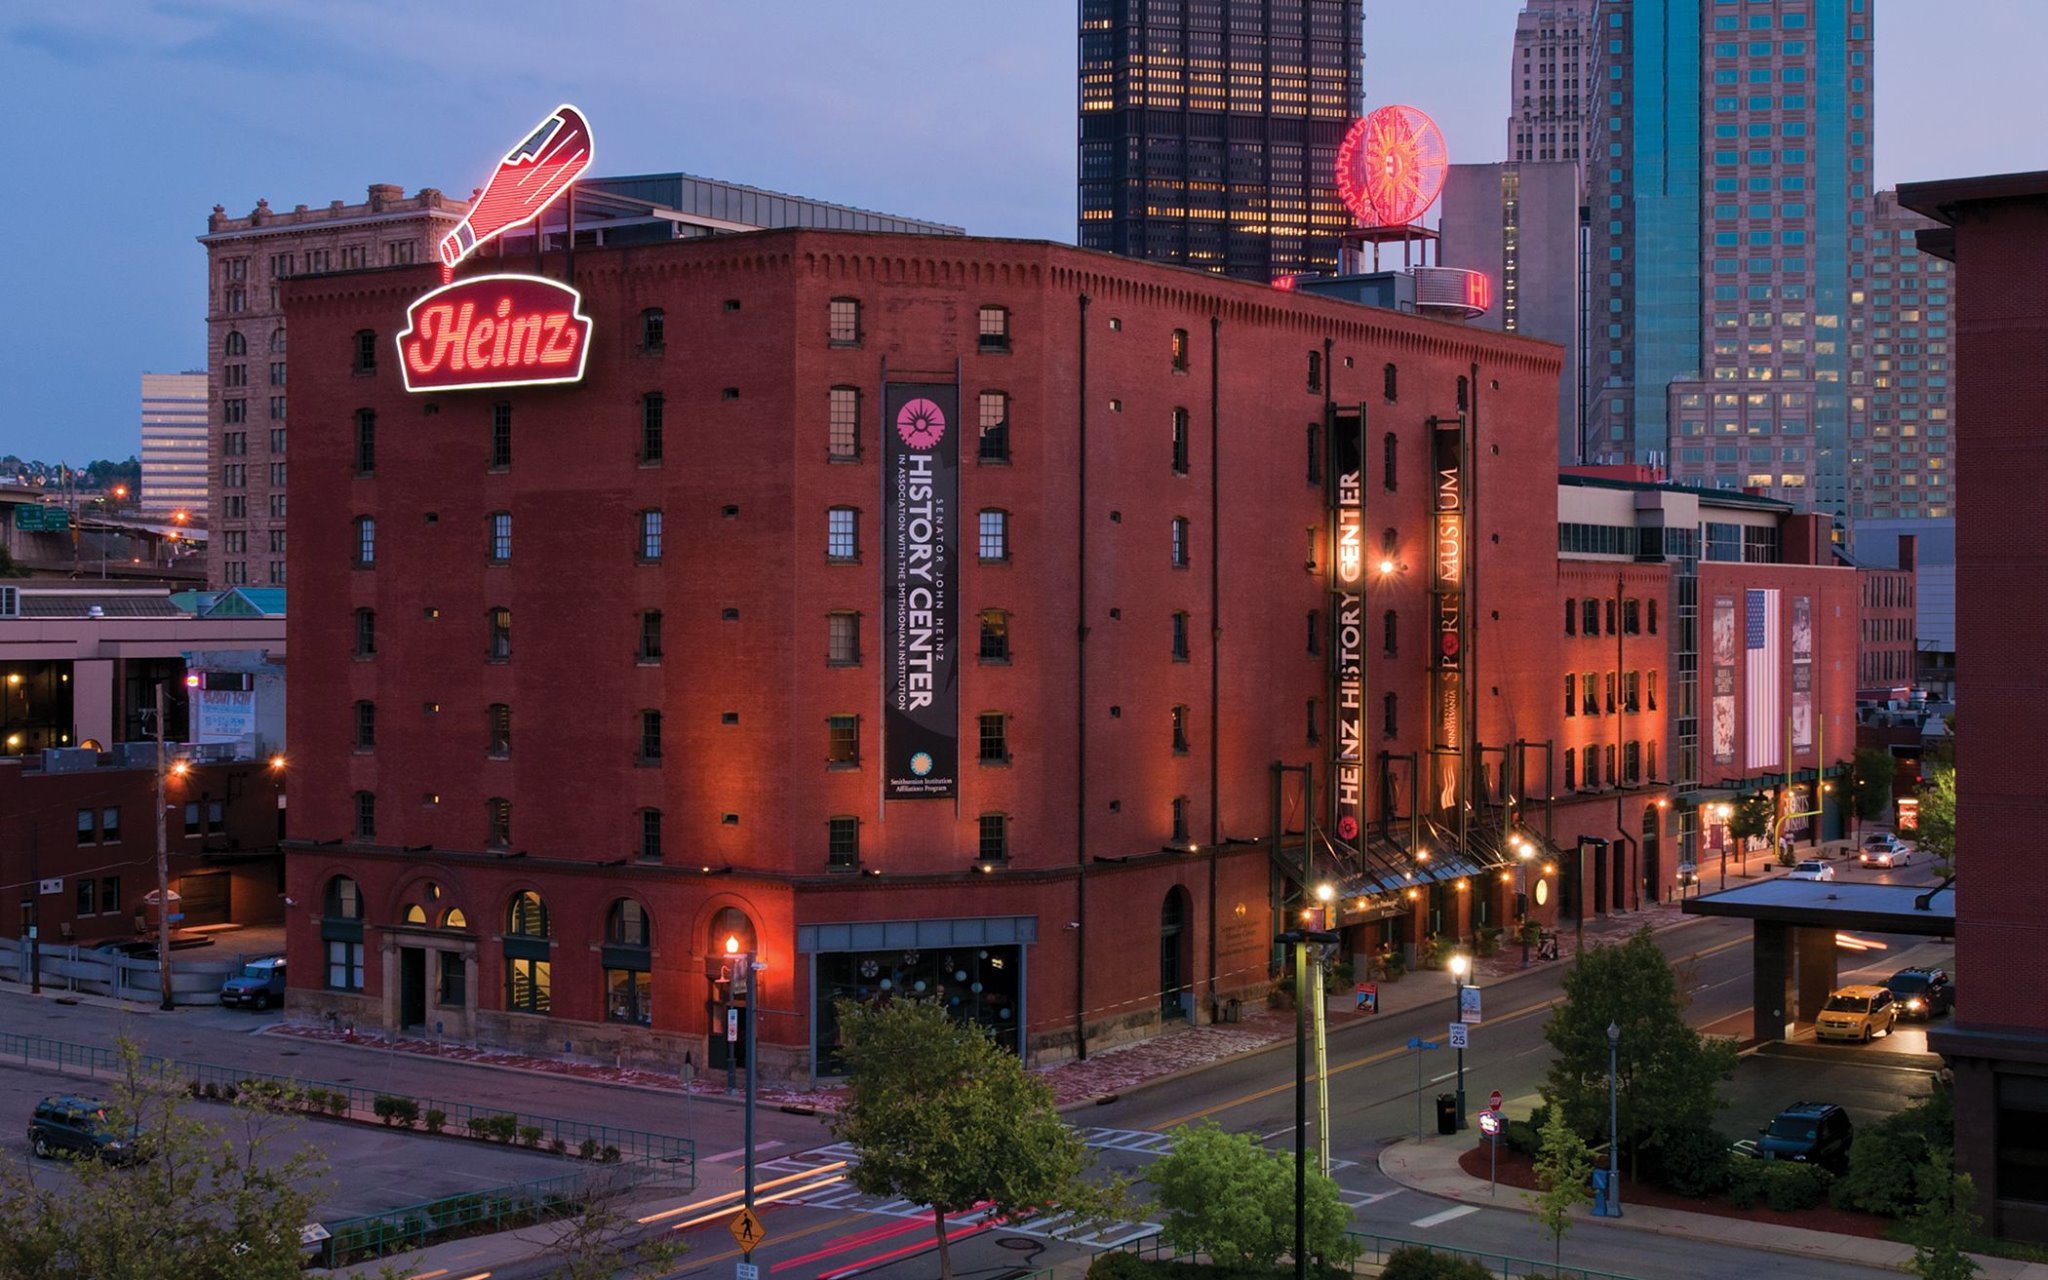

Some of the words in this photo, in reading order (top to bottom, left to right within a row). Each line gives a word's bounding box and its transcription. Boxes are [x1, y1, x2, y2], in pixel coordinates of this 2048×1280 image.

[408, 298, 578, 373] Heinz
[898, 454, 906, 464] IN
[898, 467, 906, 529] ASSOCIATION
[908, 454, 933, 582] HISTORY
[1340, 470, 1360, 583] CENTER
[1440, 467, 1459, 583] MUSEUM
[898, 533, 906, 559] WITH
[935, 498, 944, 562] SENATOR
[898, 561, 906, 580] THE
[935, 571, 944, 609] JOHN
[898, 582, 906, 648] SMITHSONIAN
[935, 618, 944, 661] HEINZ
[898, 650, 906, 710] INSTITUTION
[908, 587, 933, 712] CENTER
[1341, 591, 1360, 709] HISTORY
[1452, 1035, 1466, 1046] 25
